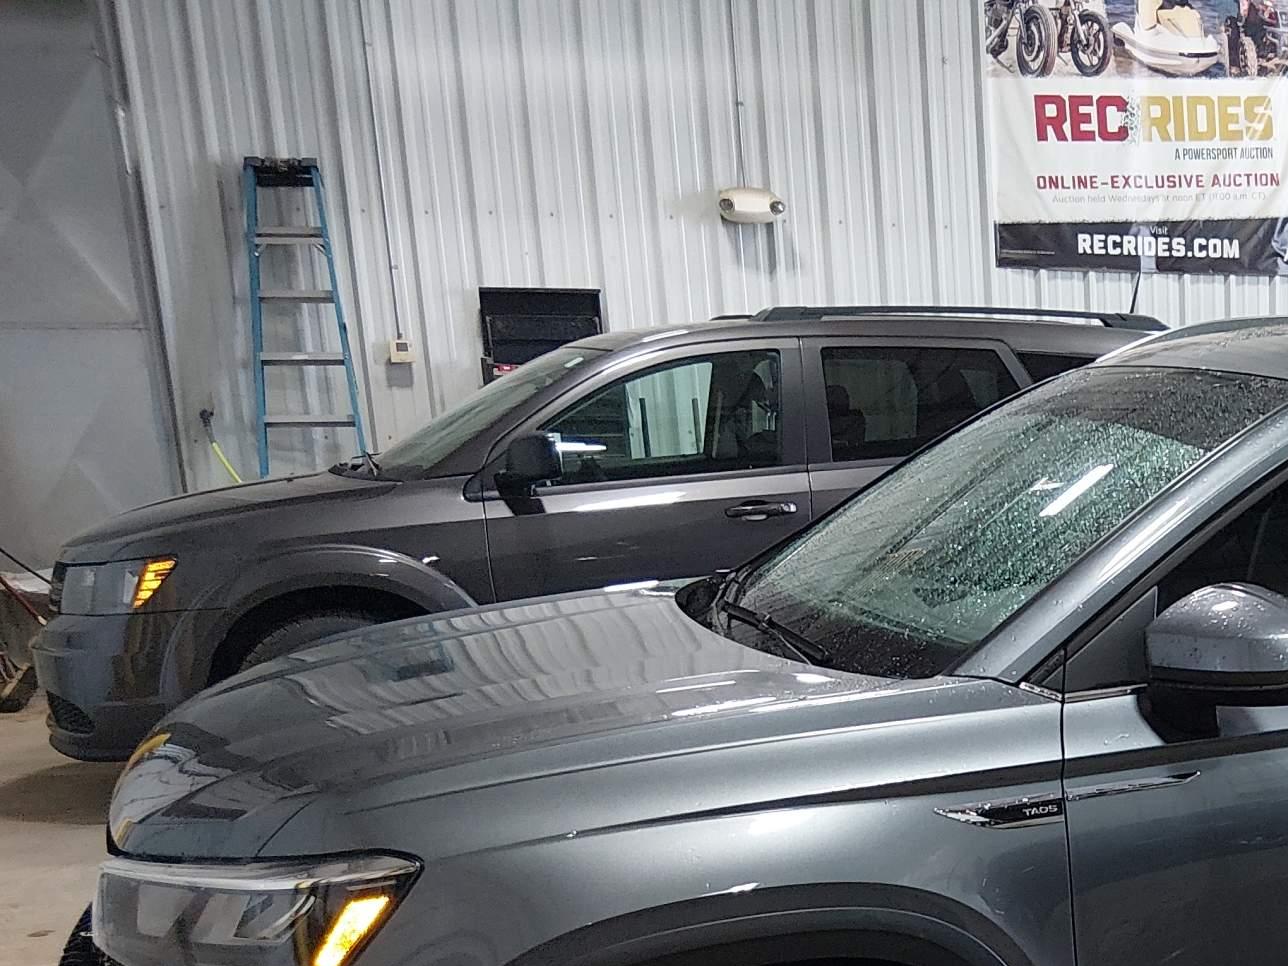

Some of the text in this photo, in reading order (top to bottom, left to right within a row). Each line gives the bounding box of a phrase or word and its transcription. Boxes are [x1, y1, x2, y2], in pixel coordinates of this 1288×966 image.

[1174, 146, 1274, 161] A POWERSPORT AUCTION
[1036, 172, 1281, 190] ONLINE-EXCLUSIVE AUCTION
[1150, 226, 1168, 235] Visit
[1077, 232, 1240, 259] RECRIDES.COM
[1022, 804, 1058, 817] TAOS
